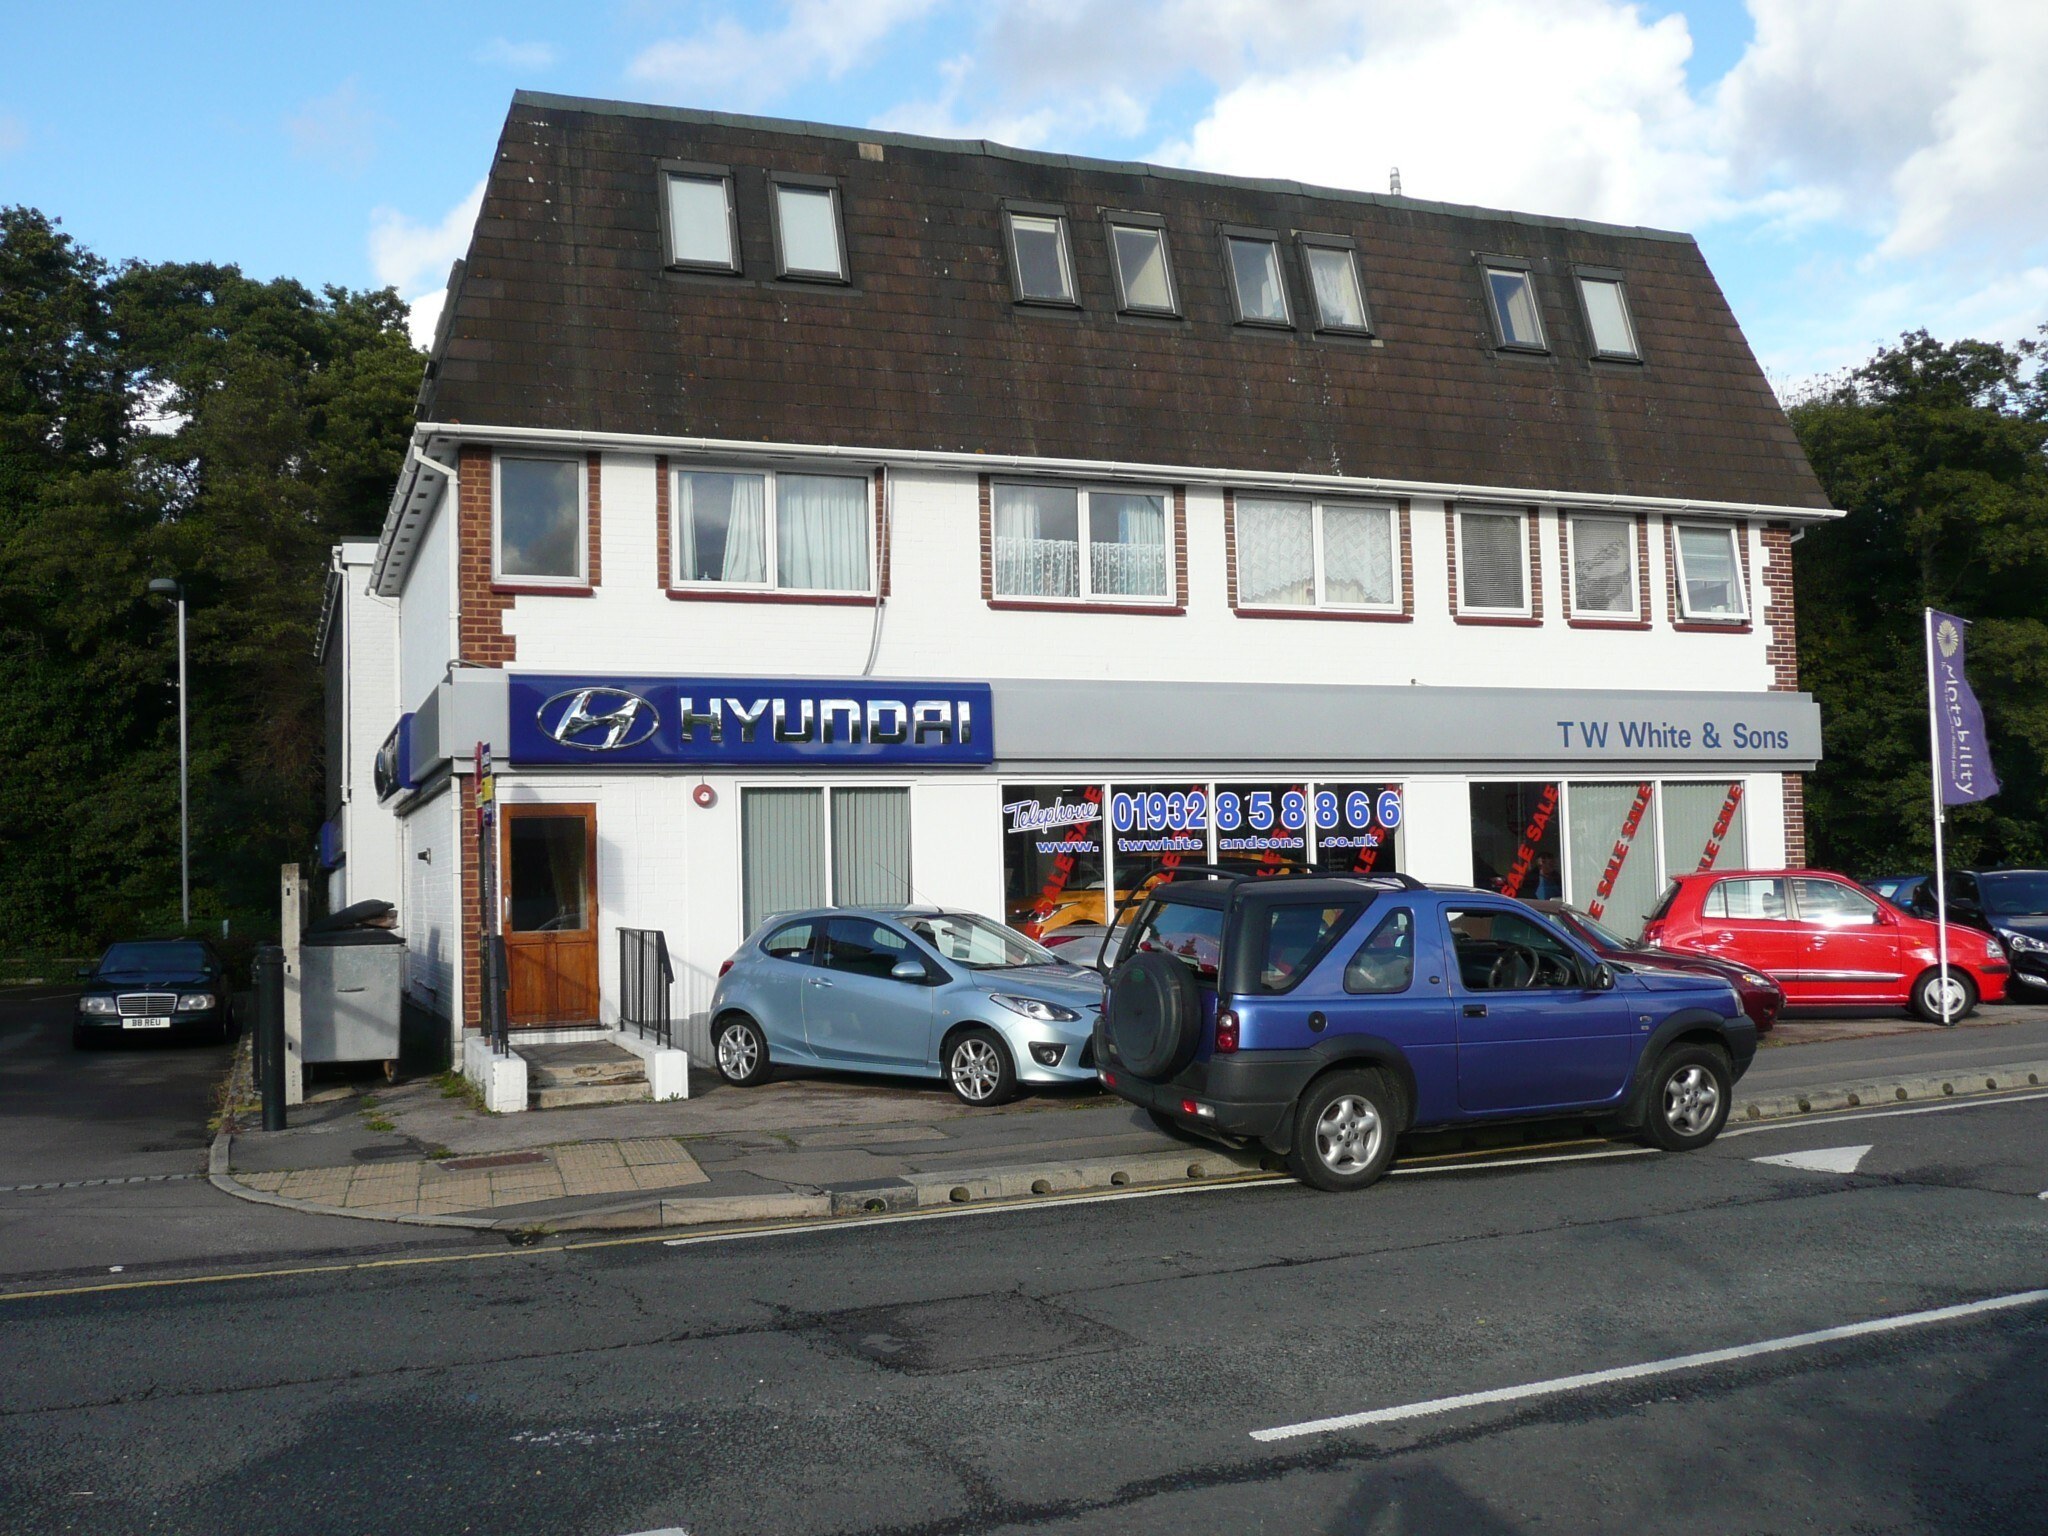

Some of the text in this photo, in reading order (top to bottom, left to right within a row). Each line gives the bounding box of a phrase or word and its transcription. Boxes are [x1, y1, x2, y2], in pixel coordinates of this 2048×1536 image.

[680, 697, 970, 744] HYUNDAI
[1619, 721, 1691, 748] White
[1702, 721, 1722, 748] &
[1733, 722, 1789, 749] Sons
[1003, 797, 1100, 834] Telephone
[1112, 791, 1207, 832] 01932
[1712, 781, 1744, 841] SALE
[1501, 784, 1559, 898] SALE SALE
[1597, 782, 1653, 899] SALE SALE
